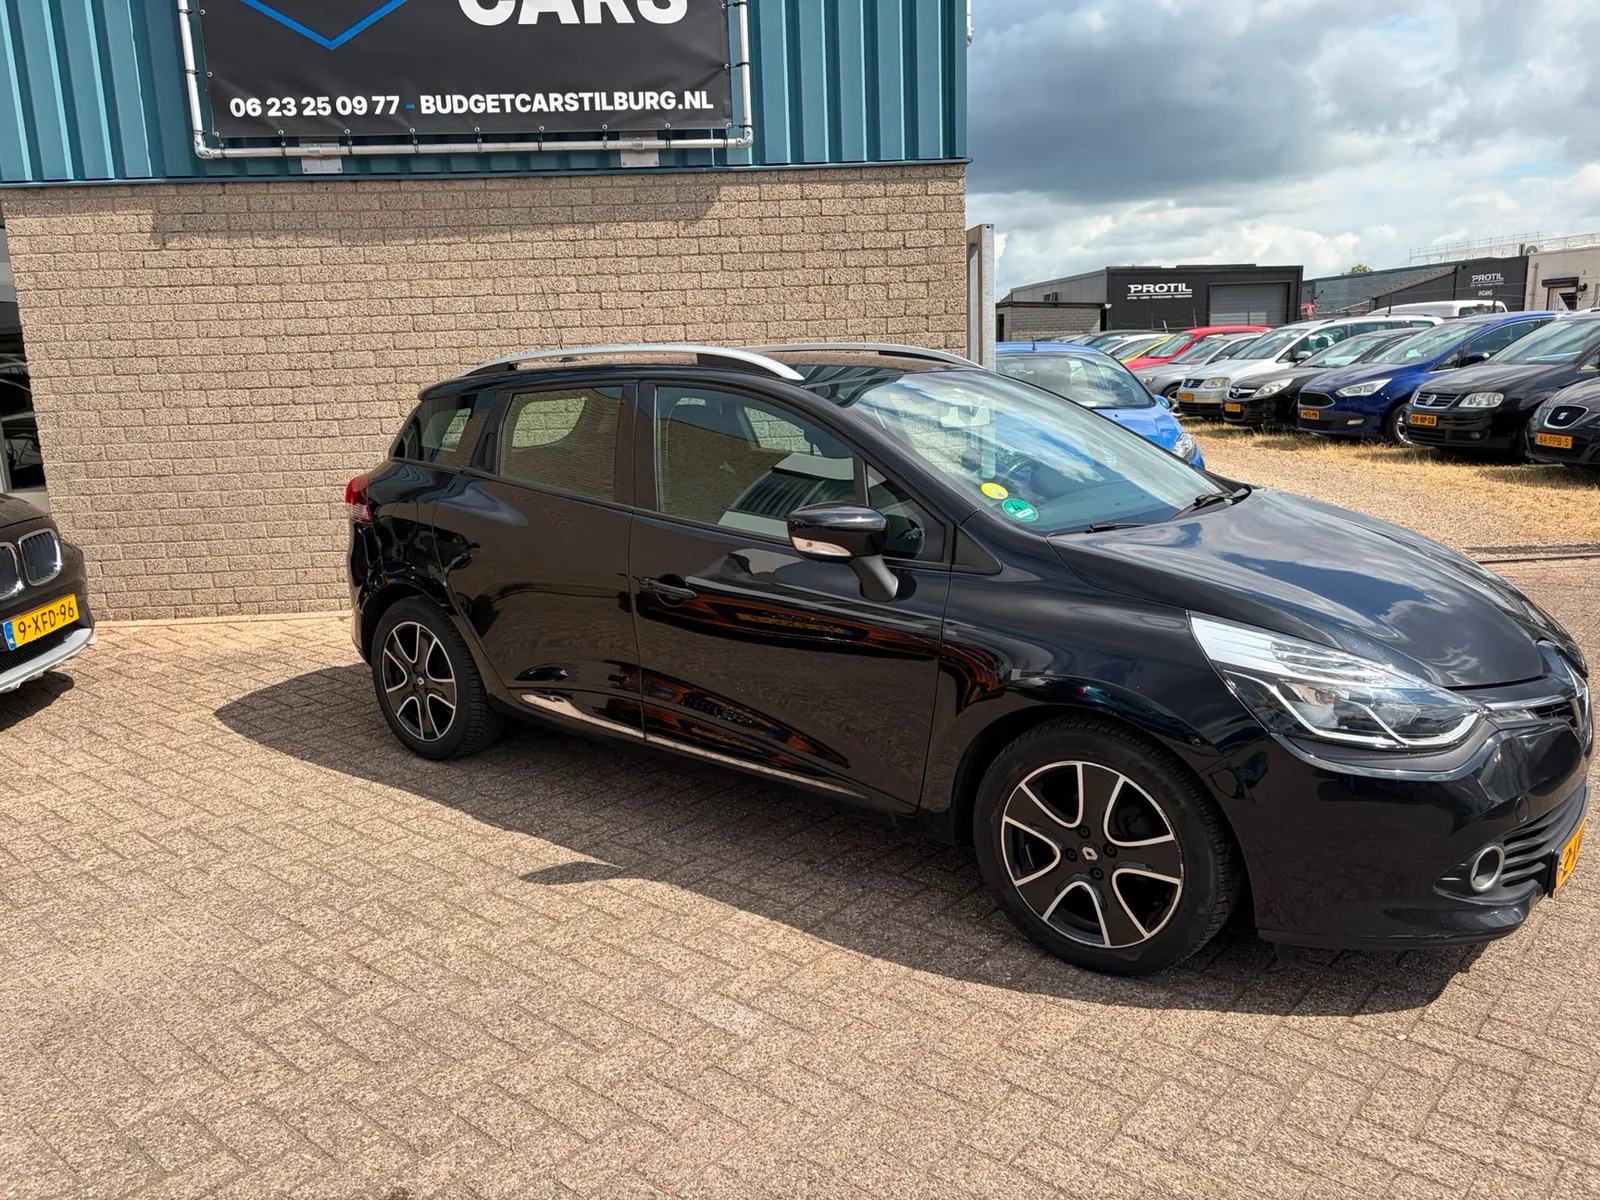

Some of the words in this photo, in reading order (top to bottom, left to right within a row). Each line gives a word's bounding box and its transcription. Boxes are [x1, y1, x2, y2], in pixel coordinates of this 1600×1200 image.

[230, 97, 262, 117] 06
[266, 96, 298, 117] 23
[301, 96, 332, 116] 25
[336, 95, 368, 116] 09
[371, 95, 400, 115] 77
[420, 90, 714, 115] BUDGETCARSTILBURG.NL
[1471, 272, 1504, 282] PROTIL
[1127, 282, 1193, 294] PROTIL
[18, 601, 75, 640] 9-XFD-96
